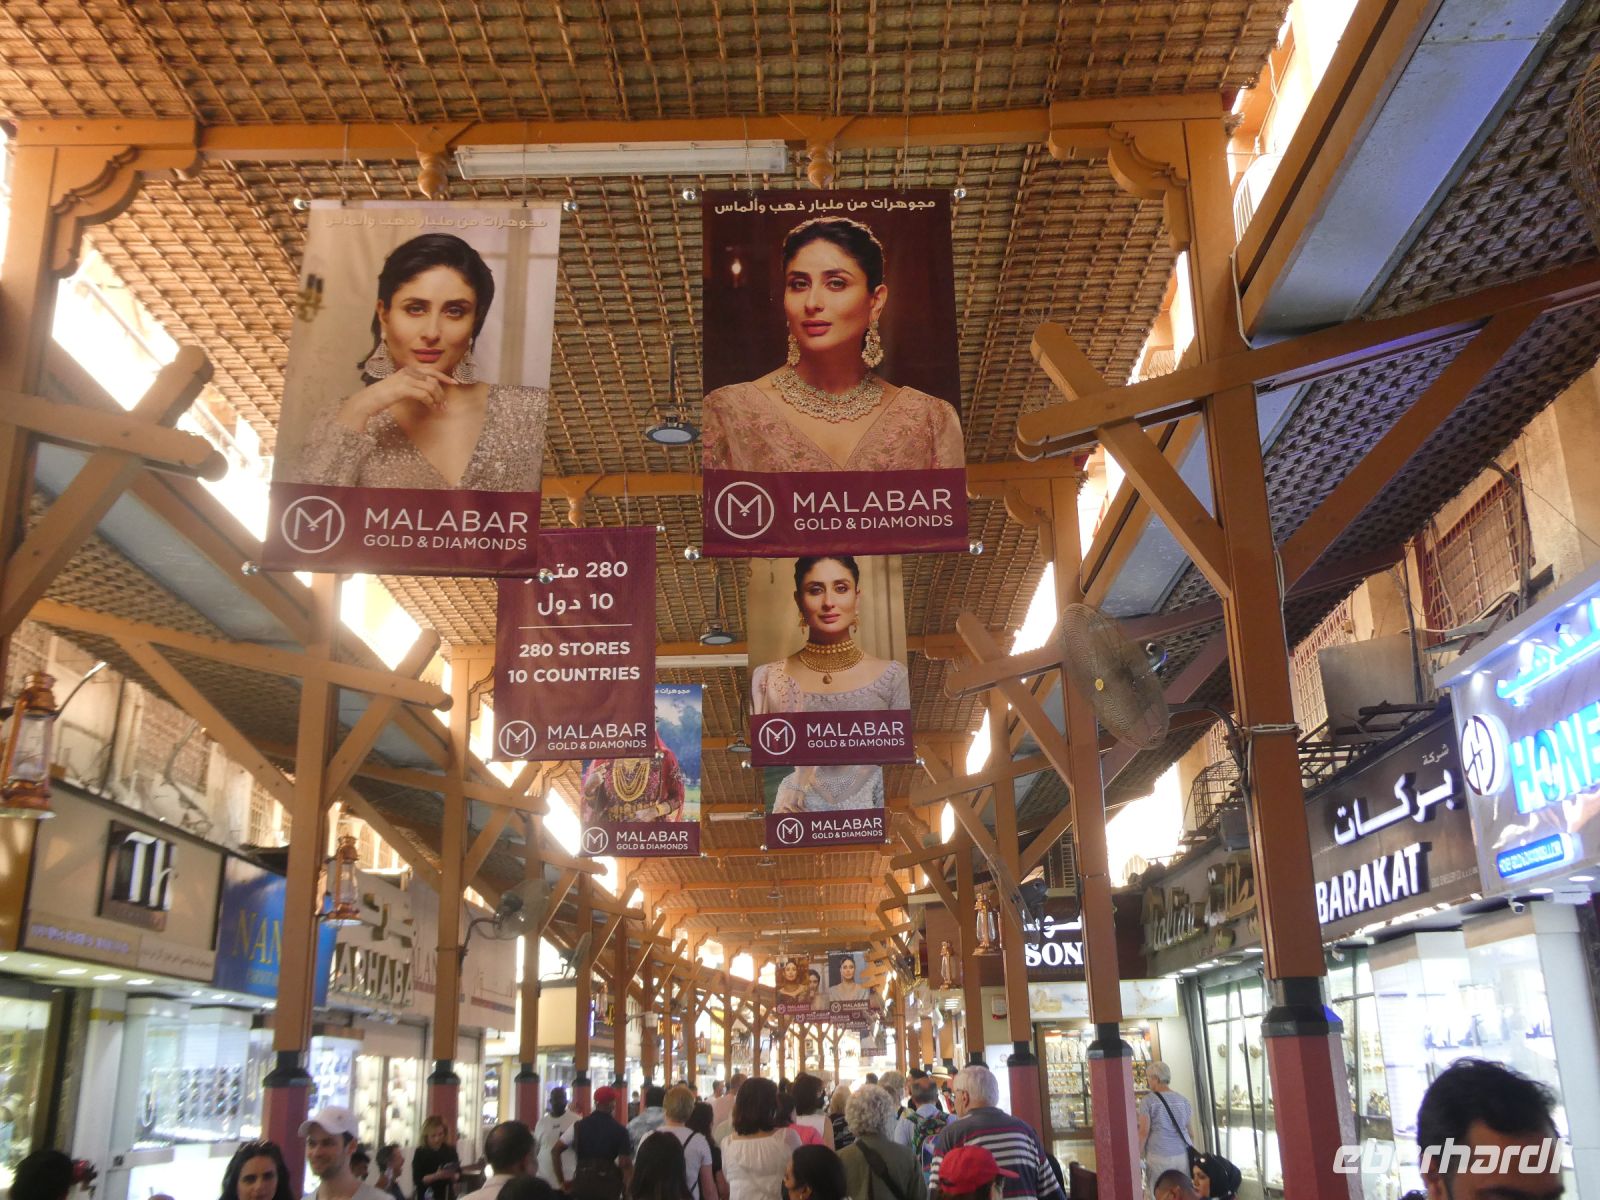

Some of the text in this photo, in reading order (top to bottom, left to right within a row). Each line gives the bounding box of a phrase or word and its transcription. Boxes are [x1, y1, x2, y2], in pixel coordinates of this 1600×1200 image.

[769, 199, 806, 214] ذهب
[808, 199, 844, 213] ملبار
[847, 198, 868, 211] من
[871, 198, 936, 212] مجوهرات
[793, 488, 952, 514] MALABAR
[364, 507, 528, 534] MALABAR
[794, 514, 953, 531] GOLD & DIAMONDS
[363, 534, 527, 550] GOLD & DIAMONDS
[585, 561, 628, 578] 280
[537, 592, 614, 616] 10 دول
[518, 641, 631, 658] 280 STORES
[507, 666, 640, 683] 10 COUNTRIES
[547, 722, 647, 740] MALABAR
[806, 721, 905, 738] MALABAR
[547, 739, 647, 751] GOLD & DIAMONDS
[807, 738, 905, 748] GOLD & DIAMONDS
[1334, 769, 1454, 845] بركات
[811, 817, 883, 831] MALABAR
[616, 830, 689, 842] MALABAR
[812, 832, 834, 840] GOLD
[841, 829, 883, 839] DIAMONDS
[1315, 842, 1421, 924] BARAKAT
